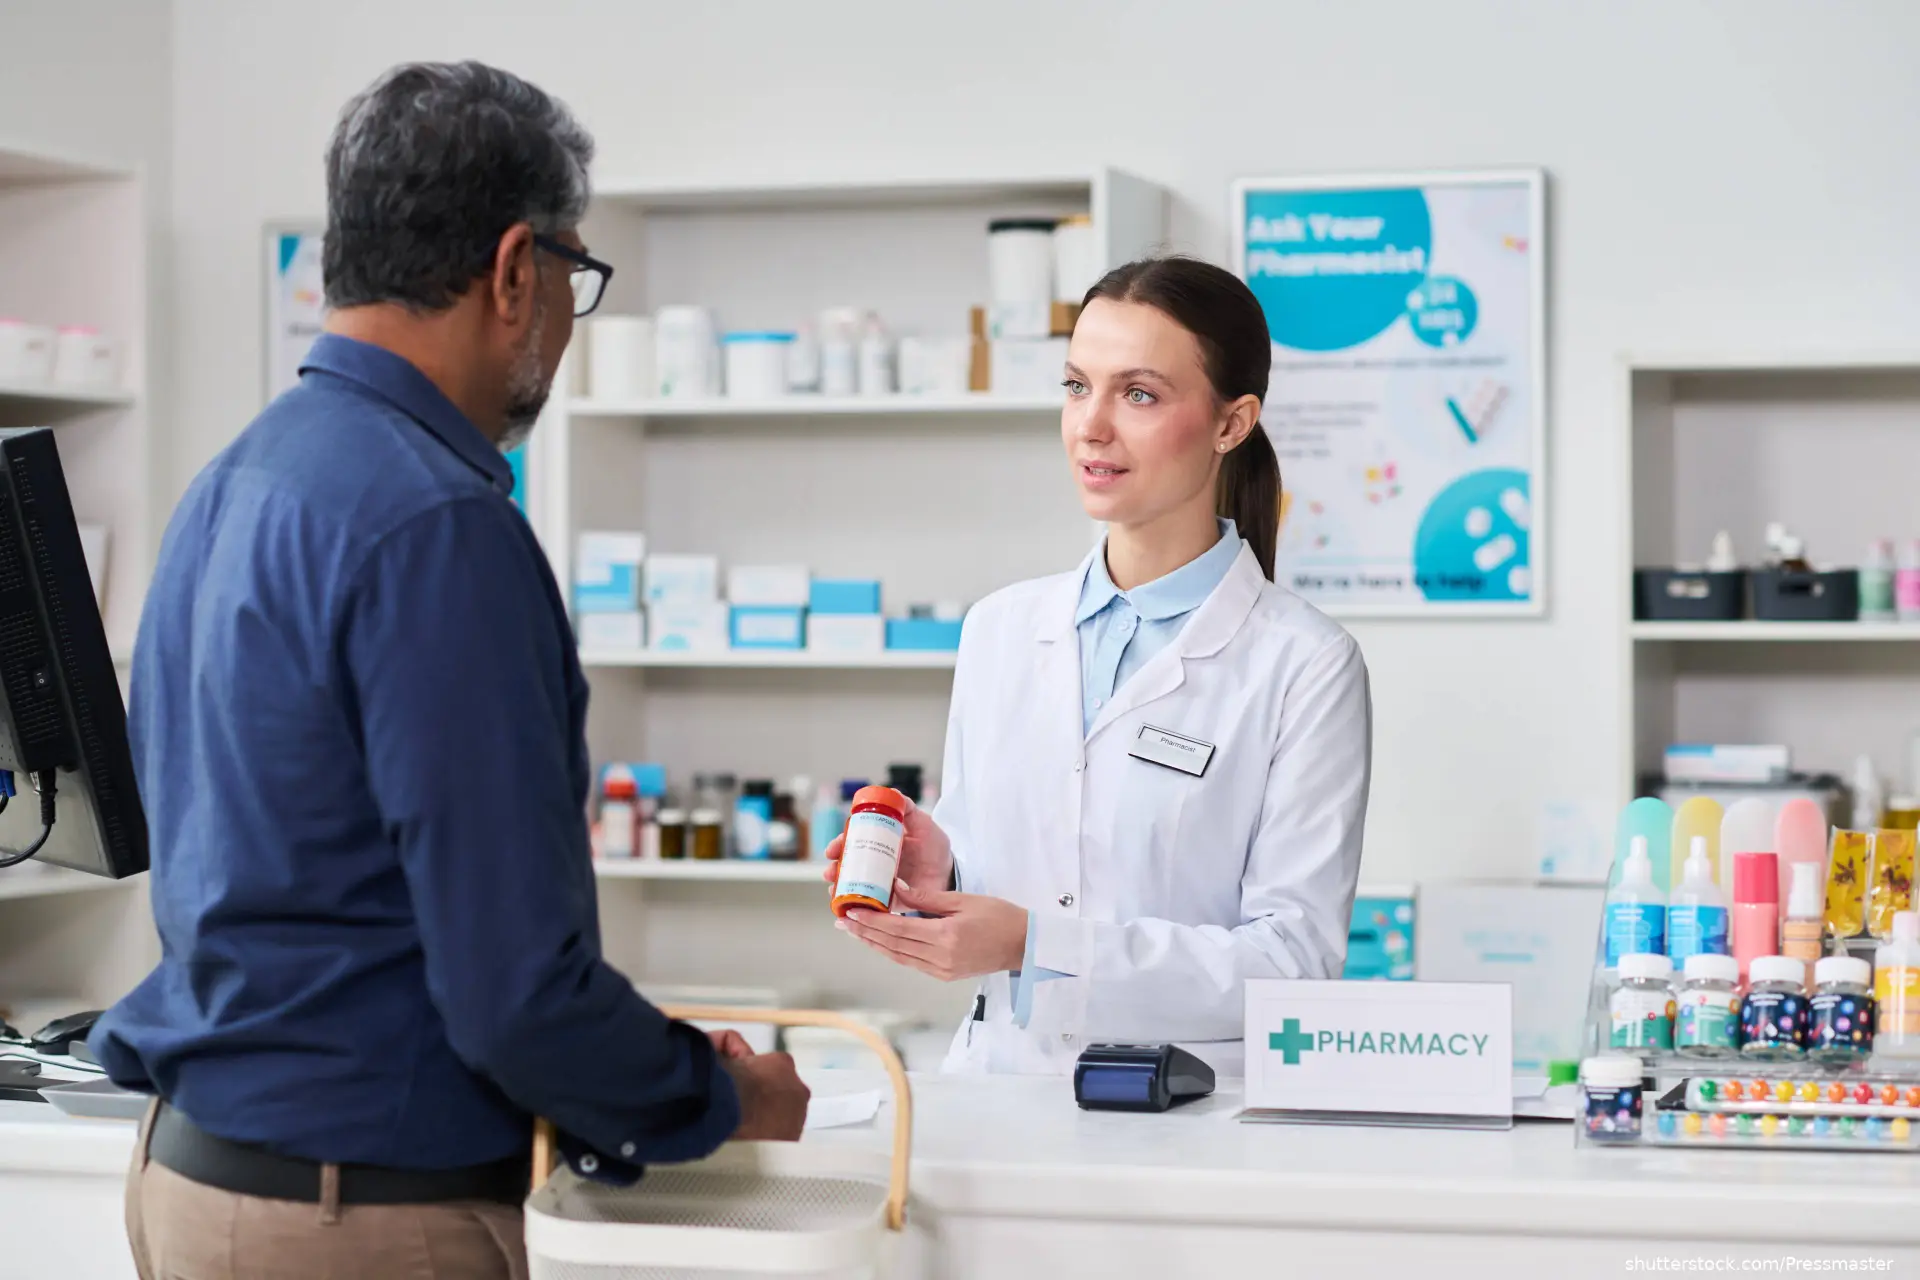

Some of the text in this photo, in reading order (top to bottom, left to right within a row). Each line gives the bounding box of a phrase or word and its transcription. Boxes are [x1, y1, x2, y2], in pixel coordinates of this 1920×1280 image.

[1248, 212, 1384, 243] Ask Your
[1248, 244, 1425, 276] Pharmacist
[1160, 737, 1196, 753] Pharmacist
[1317, 1030, 1489, 1056] PHARMACY
